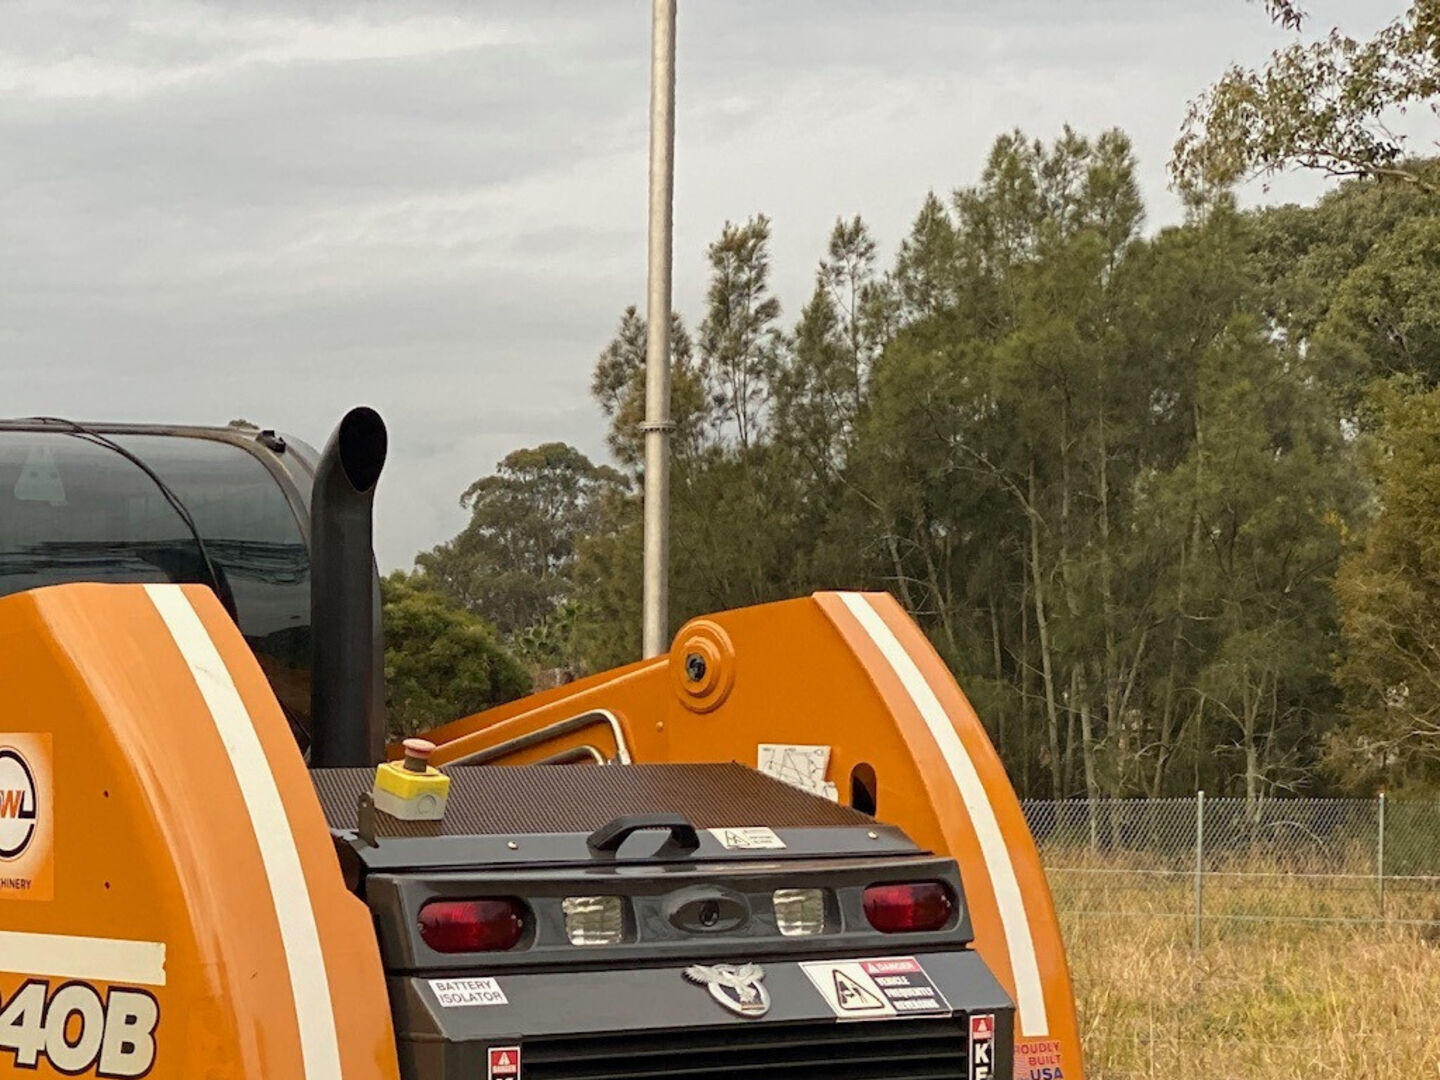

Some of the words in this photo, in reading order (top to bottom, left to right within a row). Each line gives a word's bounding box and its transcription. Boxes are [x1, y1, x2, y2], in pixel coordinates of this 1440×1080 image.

[435, 980, 492, 991] BATTERY
[439, 991, 503, 1004] ISOLATOR
[1028, 1054, 1062, 1066] BUILT
